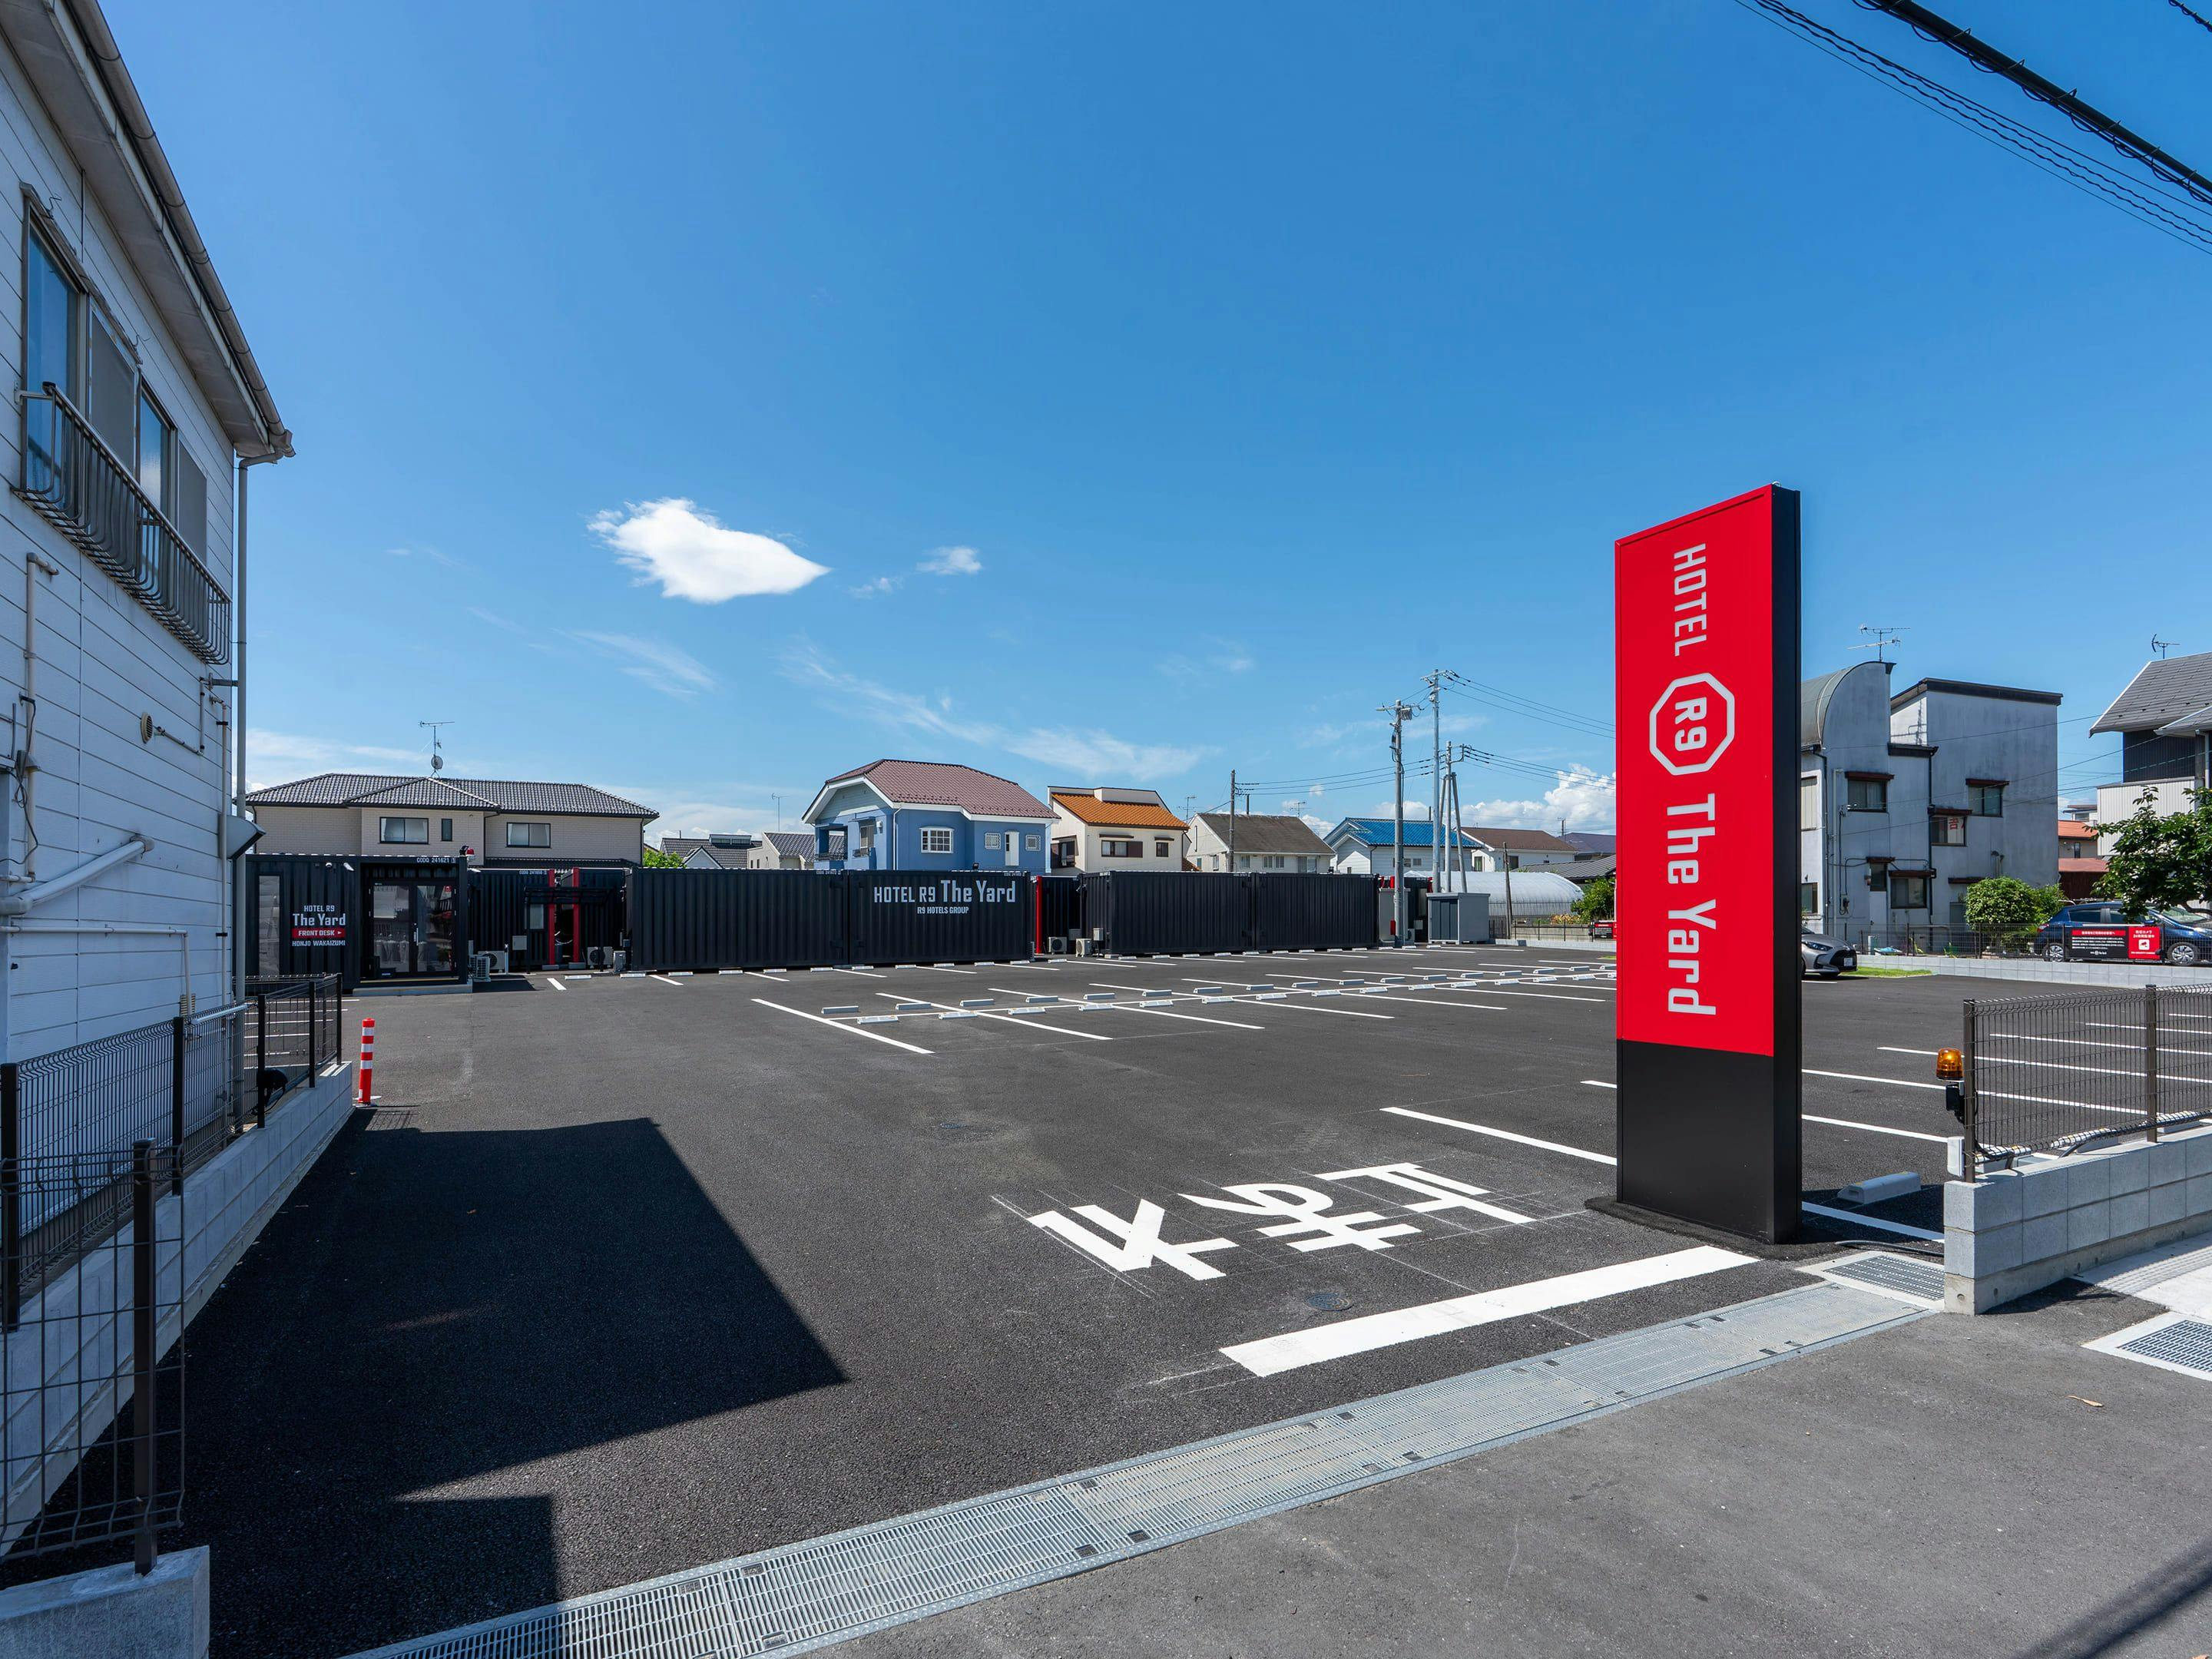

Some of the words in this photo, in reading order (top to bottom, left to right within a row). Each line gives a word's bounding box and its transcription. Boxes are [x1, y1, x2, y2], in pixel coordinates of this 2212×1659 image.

[1674, 543, 1707, 657] HOTEL
[1674, 695, 1707, 752] R9
[1667, 793, 1716, 884] The
[292, 912, 315, 926] The
[317, 912, 346, 926] Yard
[873, 886, 916, 903] HOTEL
[919, 886, 936, 902] R9
[940, 879, 972, 902] The
[975, 879, 1015, 902] Yard
[917, 906, 926, 915] R9
[926, 906, 949, 915] HOTELS
[949, 906, 969, 915] GROUP
[1667, 899, 1717, 1015] Yard
[1027, 1163, 1536, 1280] 止まれ
